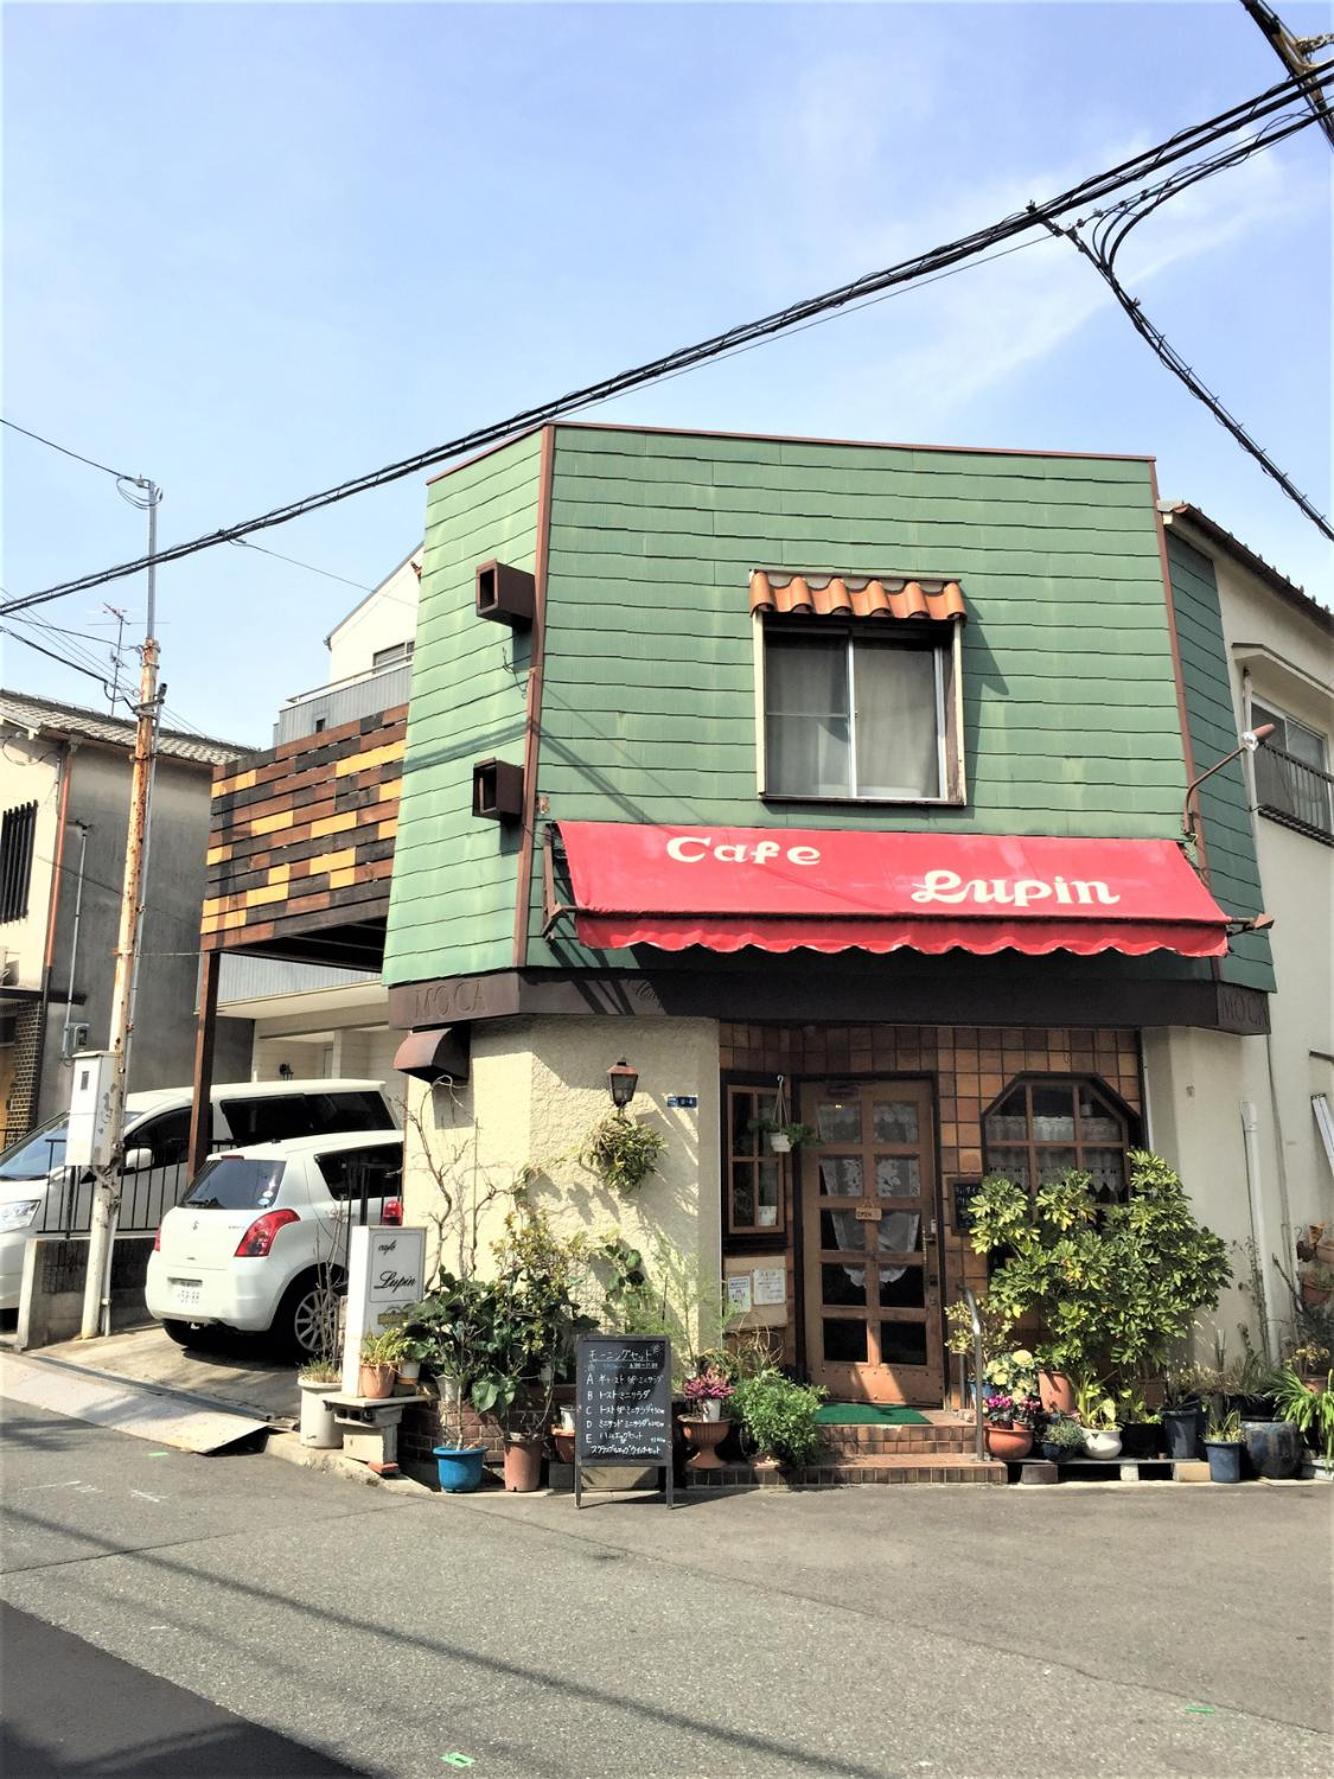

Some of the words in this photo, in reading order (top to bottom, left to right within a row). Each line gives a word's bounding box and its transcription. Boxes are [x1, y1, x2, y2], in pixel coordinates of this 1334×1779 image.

[666, 836, 821, 866] Cafe
[911, 869, 1120, 908] Lupin
[413, 979, 488, 1020] MOCA
[373, 1270, 417, 1294] Lupin
[589, 1349, 653, 1361] モーニングセット
[587, 1390, 593, 1401] B
[585, 1405, 592, 1415] C
[586, 1420, 592, 1429] D
[585, 1433, 593, 1444] E
